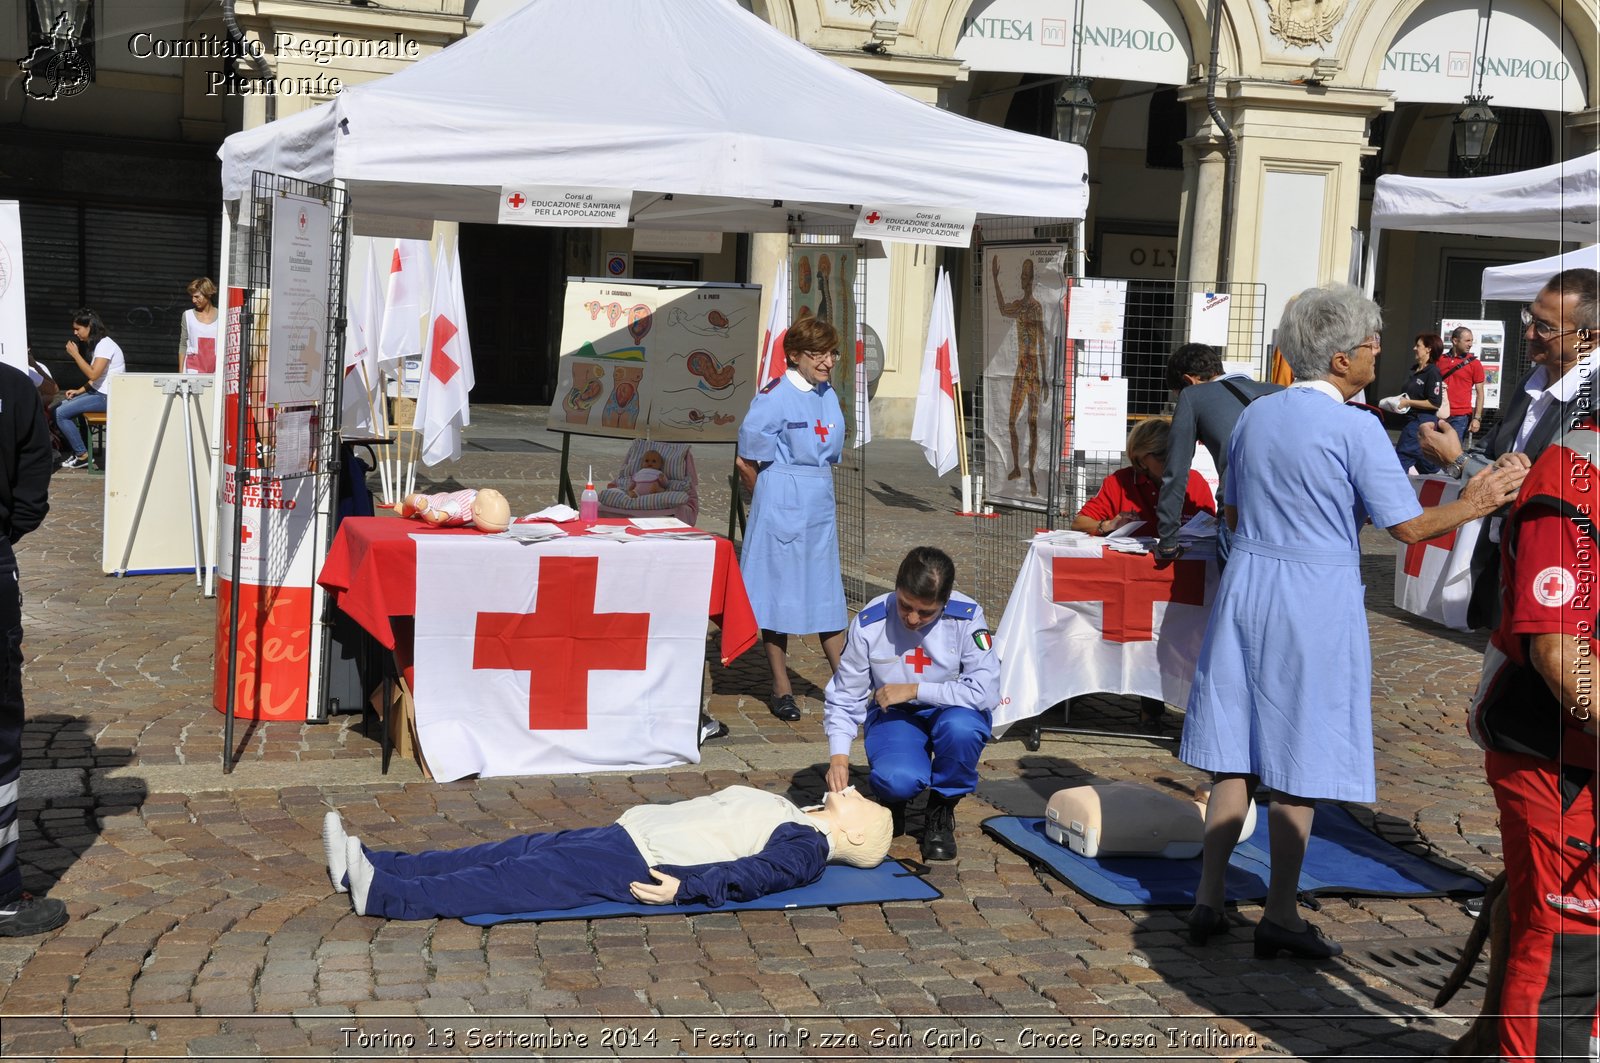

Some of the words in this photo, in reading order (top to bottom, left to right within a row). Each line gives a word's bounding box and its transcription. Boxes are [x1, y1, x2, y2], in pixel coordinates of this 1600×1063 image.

[963, 17, 1034, 41] INTESA
[1073, 24, 1175, 53] SANPAOLO
[1382, 51, 1441, 74] NTESA
[1475, 55, 1570, 81] SANPAOLO
[585, 193, 593, 201] di
[531, 201, 580, 209] EDUCAZIONE
[582, 202, 621, 210] SANITARIA
[534, 208, 550, 216] PER
[563, 209, 616, 217] POPOLAZIONE
[916, 212, 933, 220] Corsi
[885, 218, 929, 227] EDUCAZIONE
[930, 221, 965, 231] SANITARIA
[912, 227, 960, 237] POPOLAZIONE
[225, 482, 260, 498] ANHE
[263, 488, 283, 499] TU
